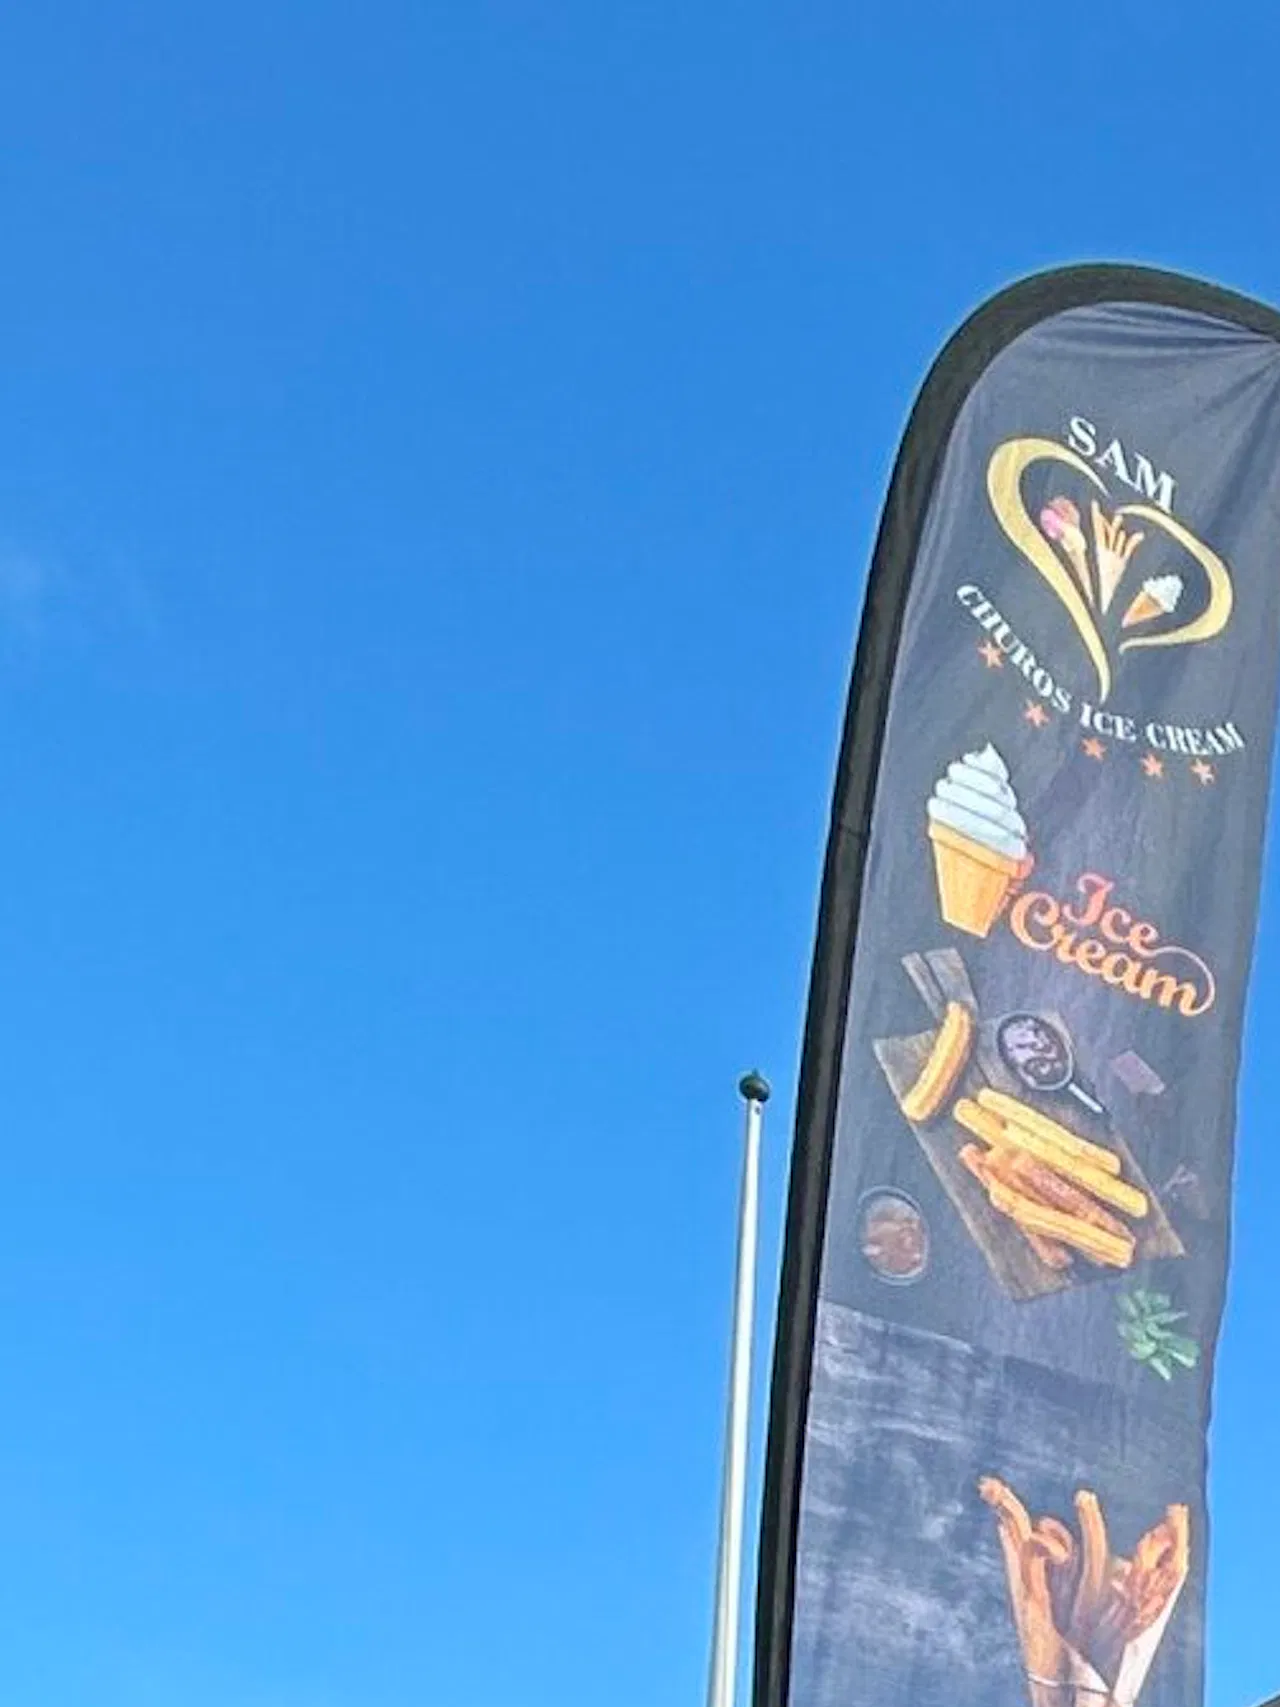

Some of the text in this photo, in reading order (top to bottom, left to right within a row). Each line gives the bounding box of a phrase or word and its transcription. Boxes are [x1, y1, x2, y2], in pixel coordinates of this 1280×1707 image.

[1067, 416, 1177, 514] SAM
[956, 585, 1246, 756] CHUROS ICE CREAM
[1010, 892, 1215, 1018] Cream
